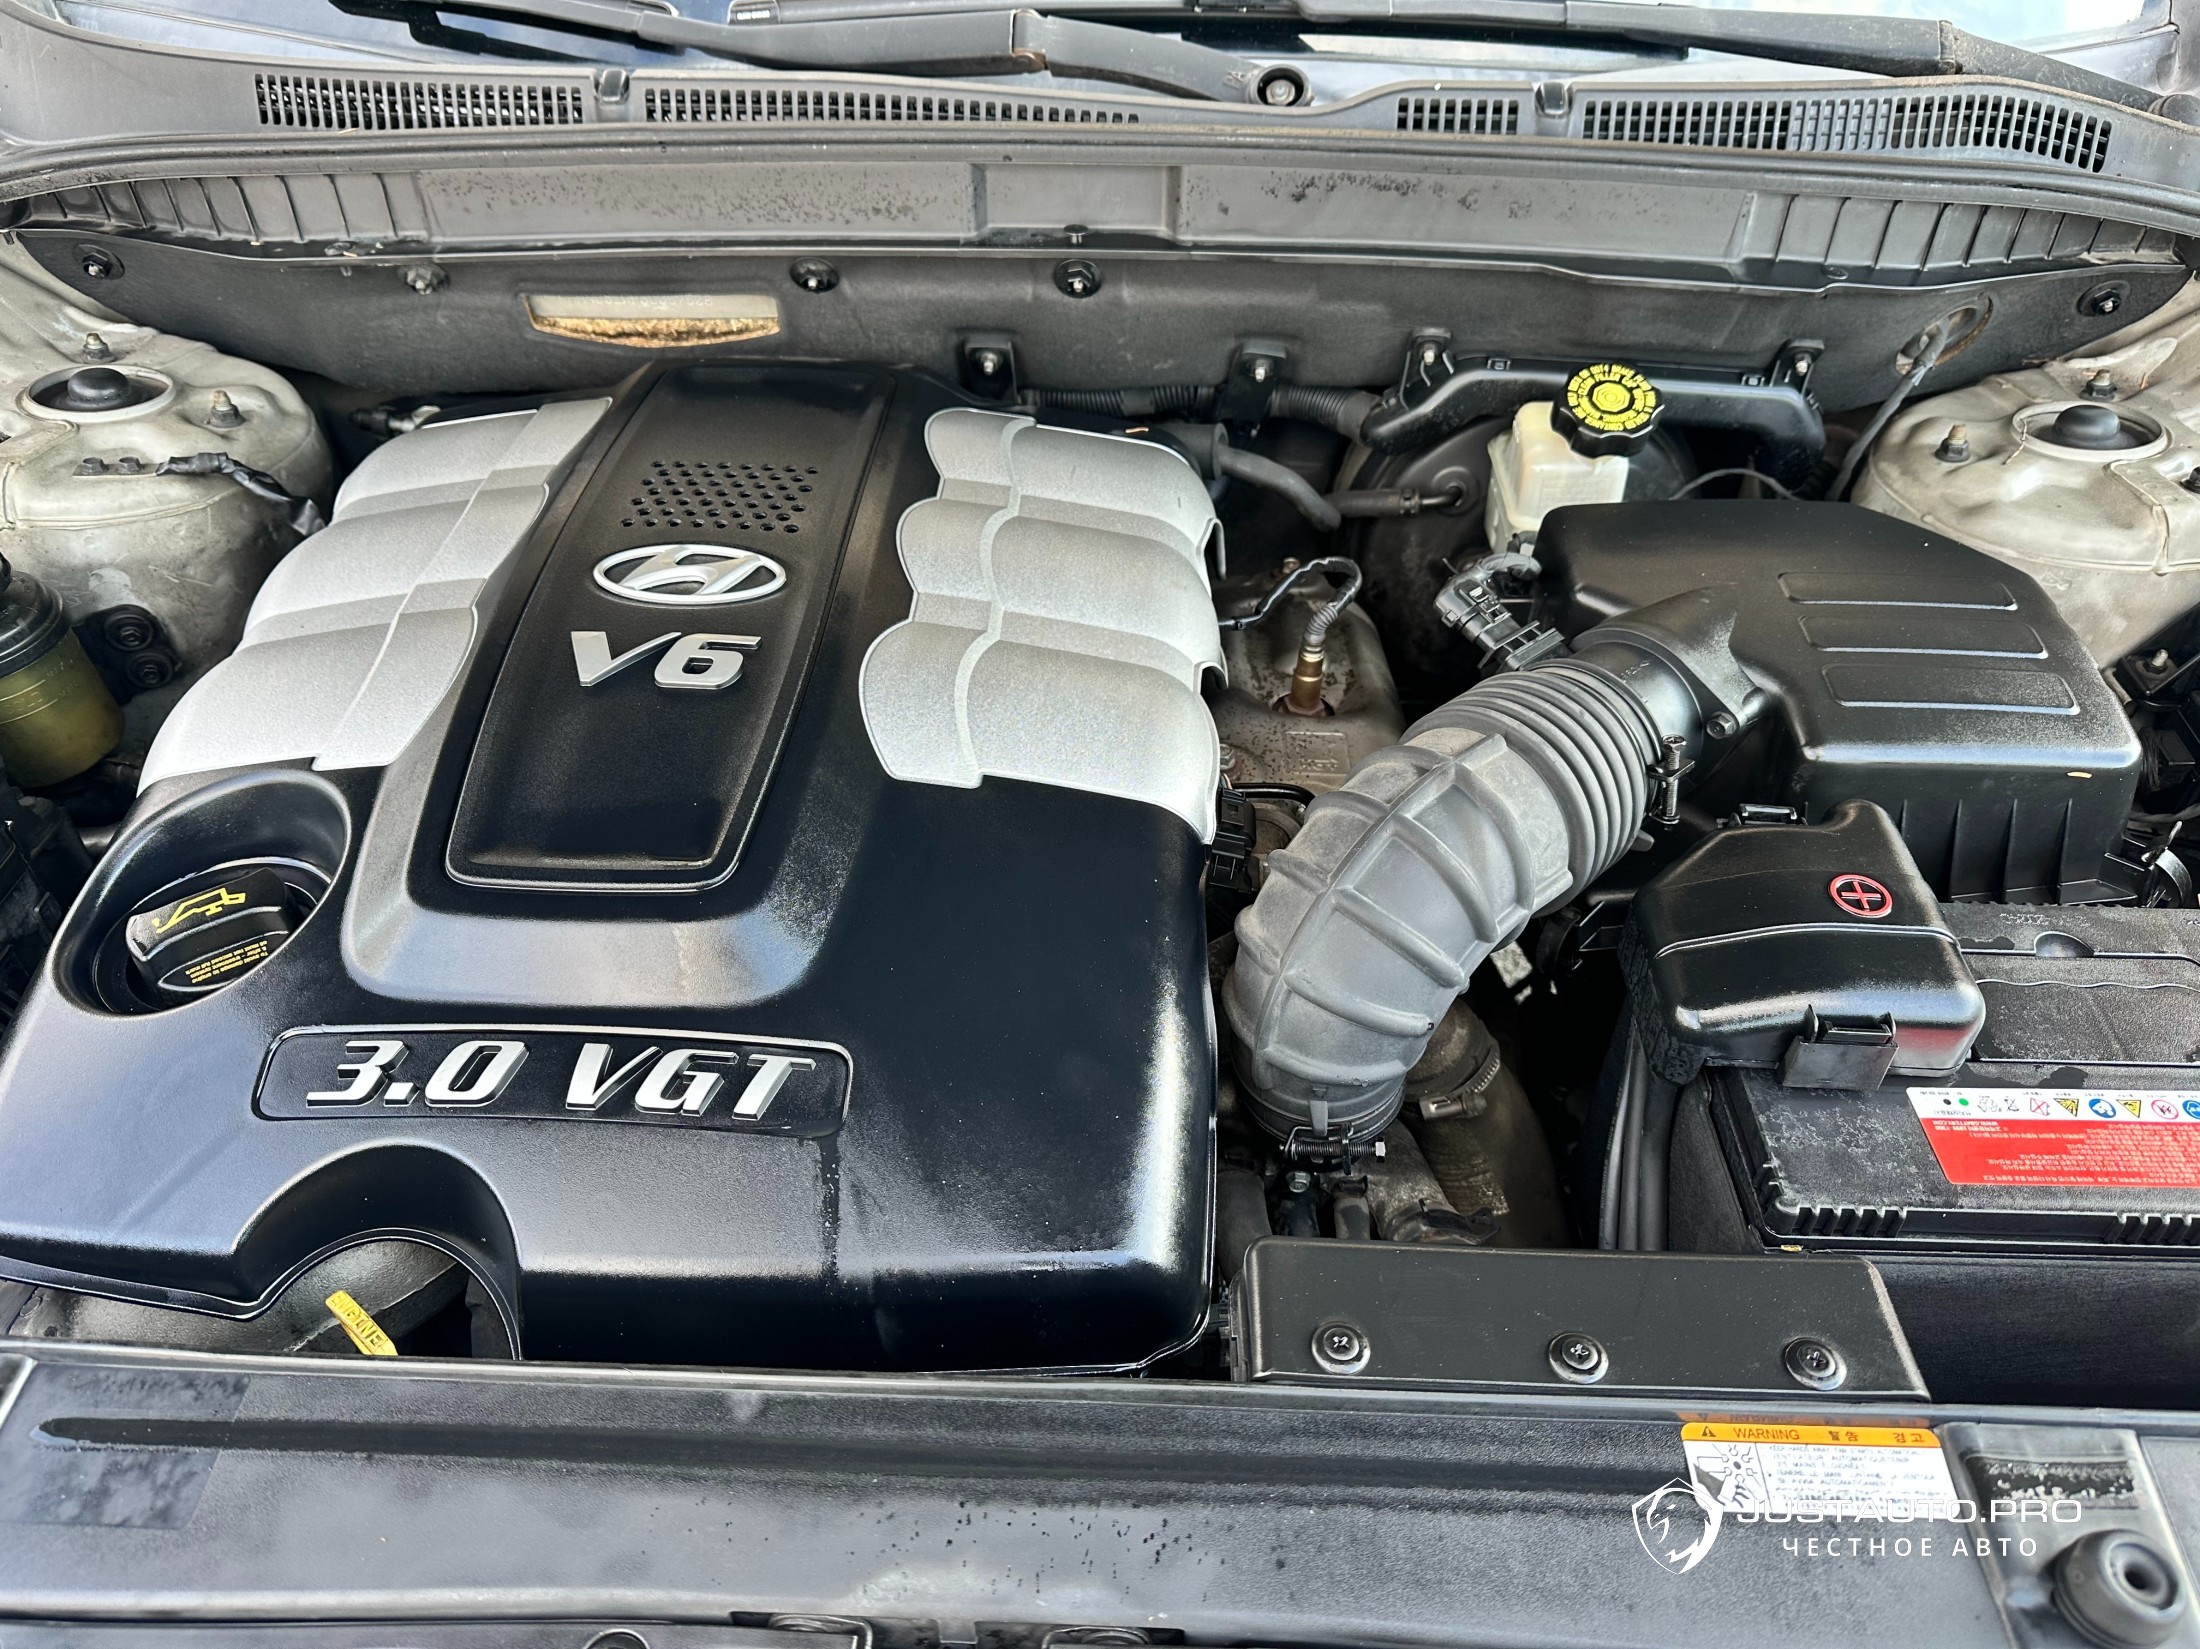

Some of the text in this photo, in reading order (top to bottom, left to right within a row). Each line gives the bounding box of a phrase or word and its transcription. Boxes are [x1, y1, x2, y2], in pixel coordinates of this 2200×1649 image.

[570, 630, 762, 690] V6
[306, 1040, 816, 1120] 3.0 VGT
[331, 1295, 385, 1348] ENGINE
[1733, 1426, 1800, 1440] WARNING
